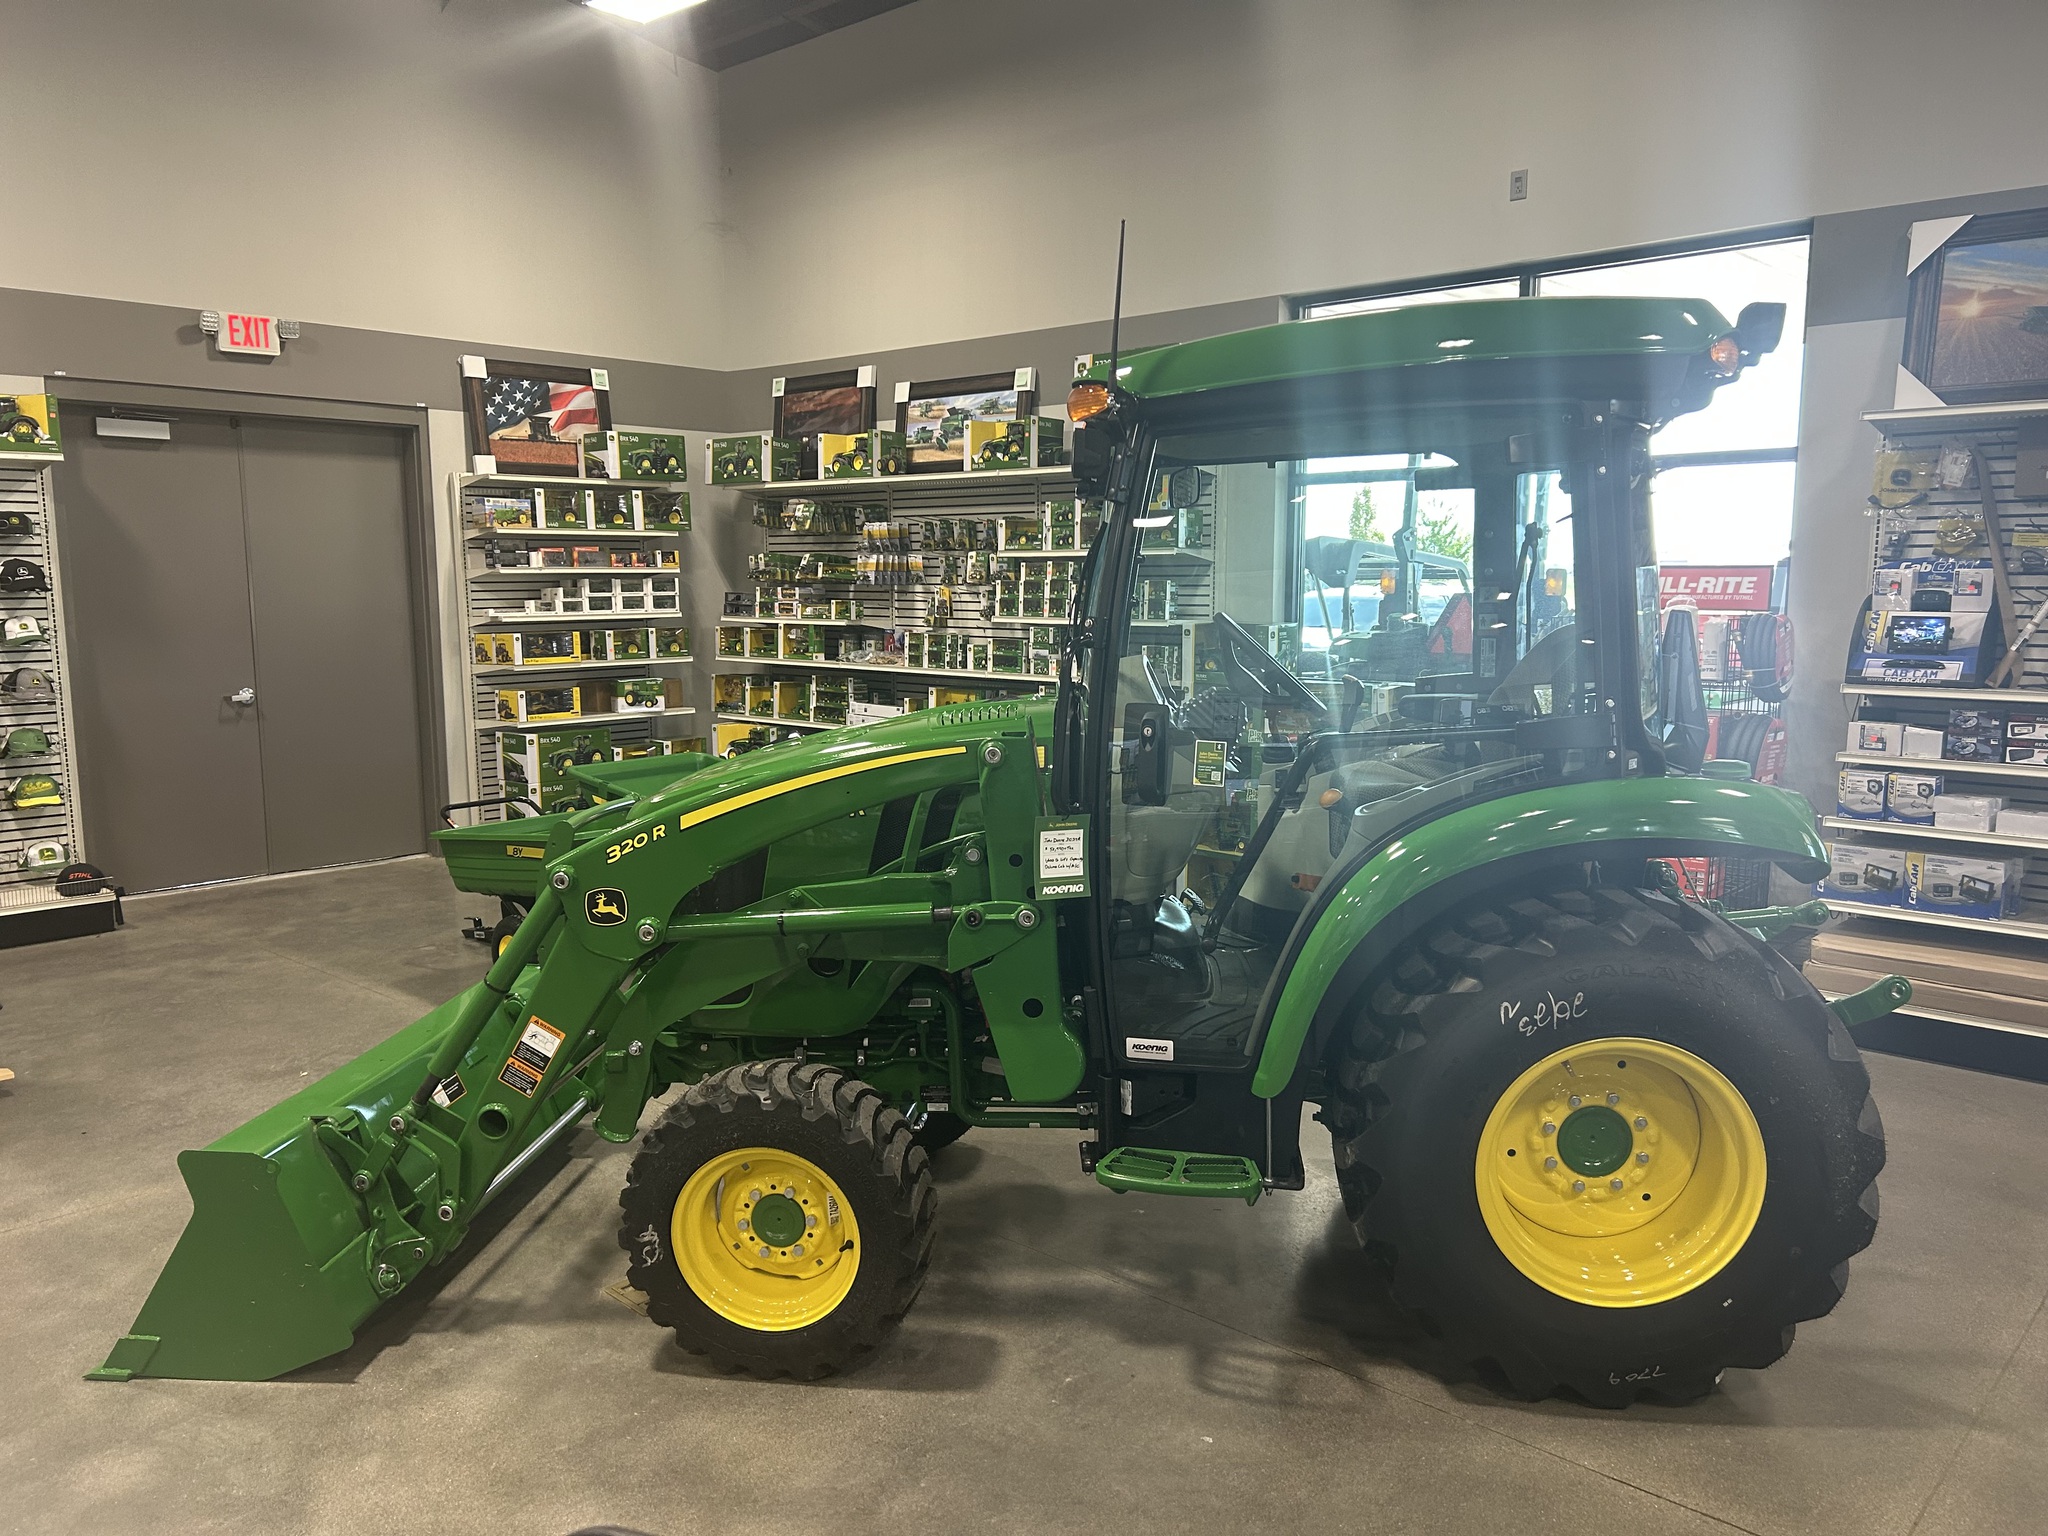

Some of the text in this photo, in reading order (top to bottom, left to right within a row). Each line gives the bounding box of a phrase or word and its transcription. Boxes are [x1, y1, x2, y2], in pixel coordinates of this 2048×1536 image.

[228, 314, 270, 349] EXIT
[1659, 576, 1758, 594] ILL-RITE
[1883, 668, 1939, 678] CAB CAM
[553, 784, 564, 792] 540
[606, 824, 667, 865] 320 R
[69, 872, 93, 880] STIHL
[1908, 863, 1920, 905] CabCAM
[540, 1021, 561, 1037] WARNING
[516, 1063, 539, 1079] WARNING
